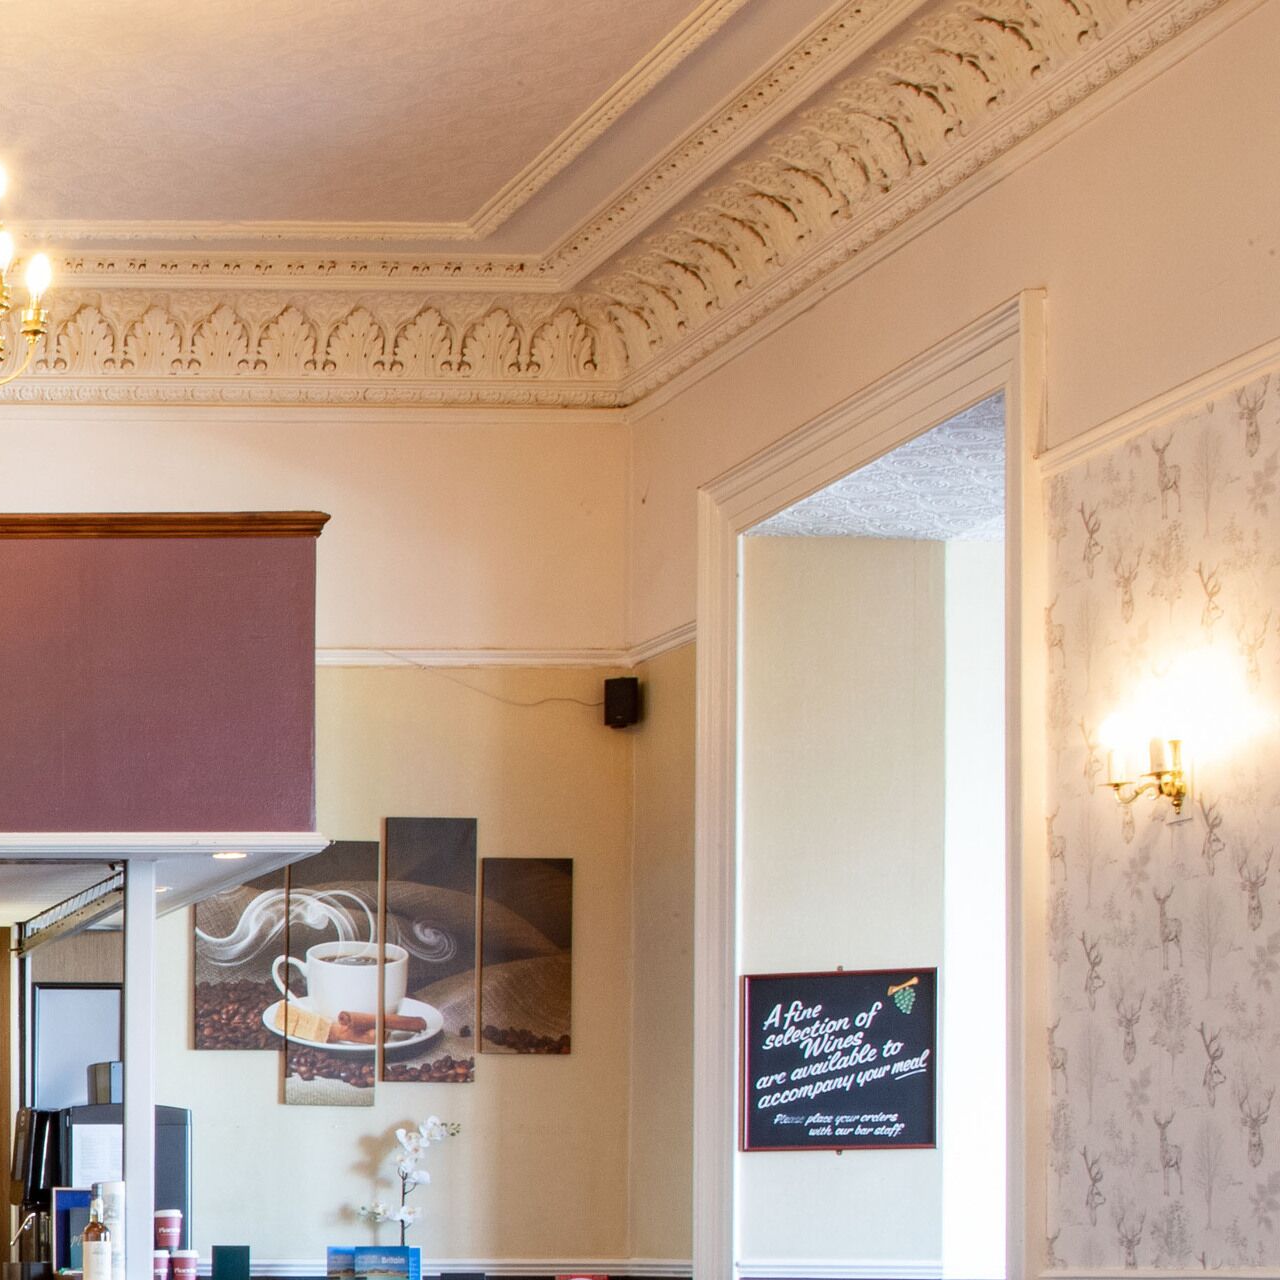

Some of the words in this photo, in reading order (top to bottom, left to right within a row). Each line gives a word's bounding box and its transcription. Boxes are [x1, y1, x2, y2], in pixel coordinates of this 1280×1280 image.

[762, 1004, 782, 1031] A
[783, 1001, 822, 1030] fine
[762, 1015, 851, 1050] selection
[855, 1002, 883, 1027] of
[800, 1032, 864, 1059] Wines
[755, 1071, 787, 1090] are
[791, 1047, 877, 1081] available
[882, 1039, 904, 1059] to
[757, 1075, 853, 1109] accompany
[856, 1069, 891, 1088] your
[891, 1049, 930, 1075] meal
[805, 1112, 833, 1126] place
[834, 1115, 859, 1126] your
[860, 1112, 898, 1122] orders
[808, 1126, 833, 1136] with
[835, 1128, 854, 1136] our
[855, 1126, 874, 1136] bar
[381, 1256, 405, 1264] Britain
